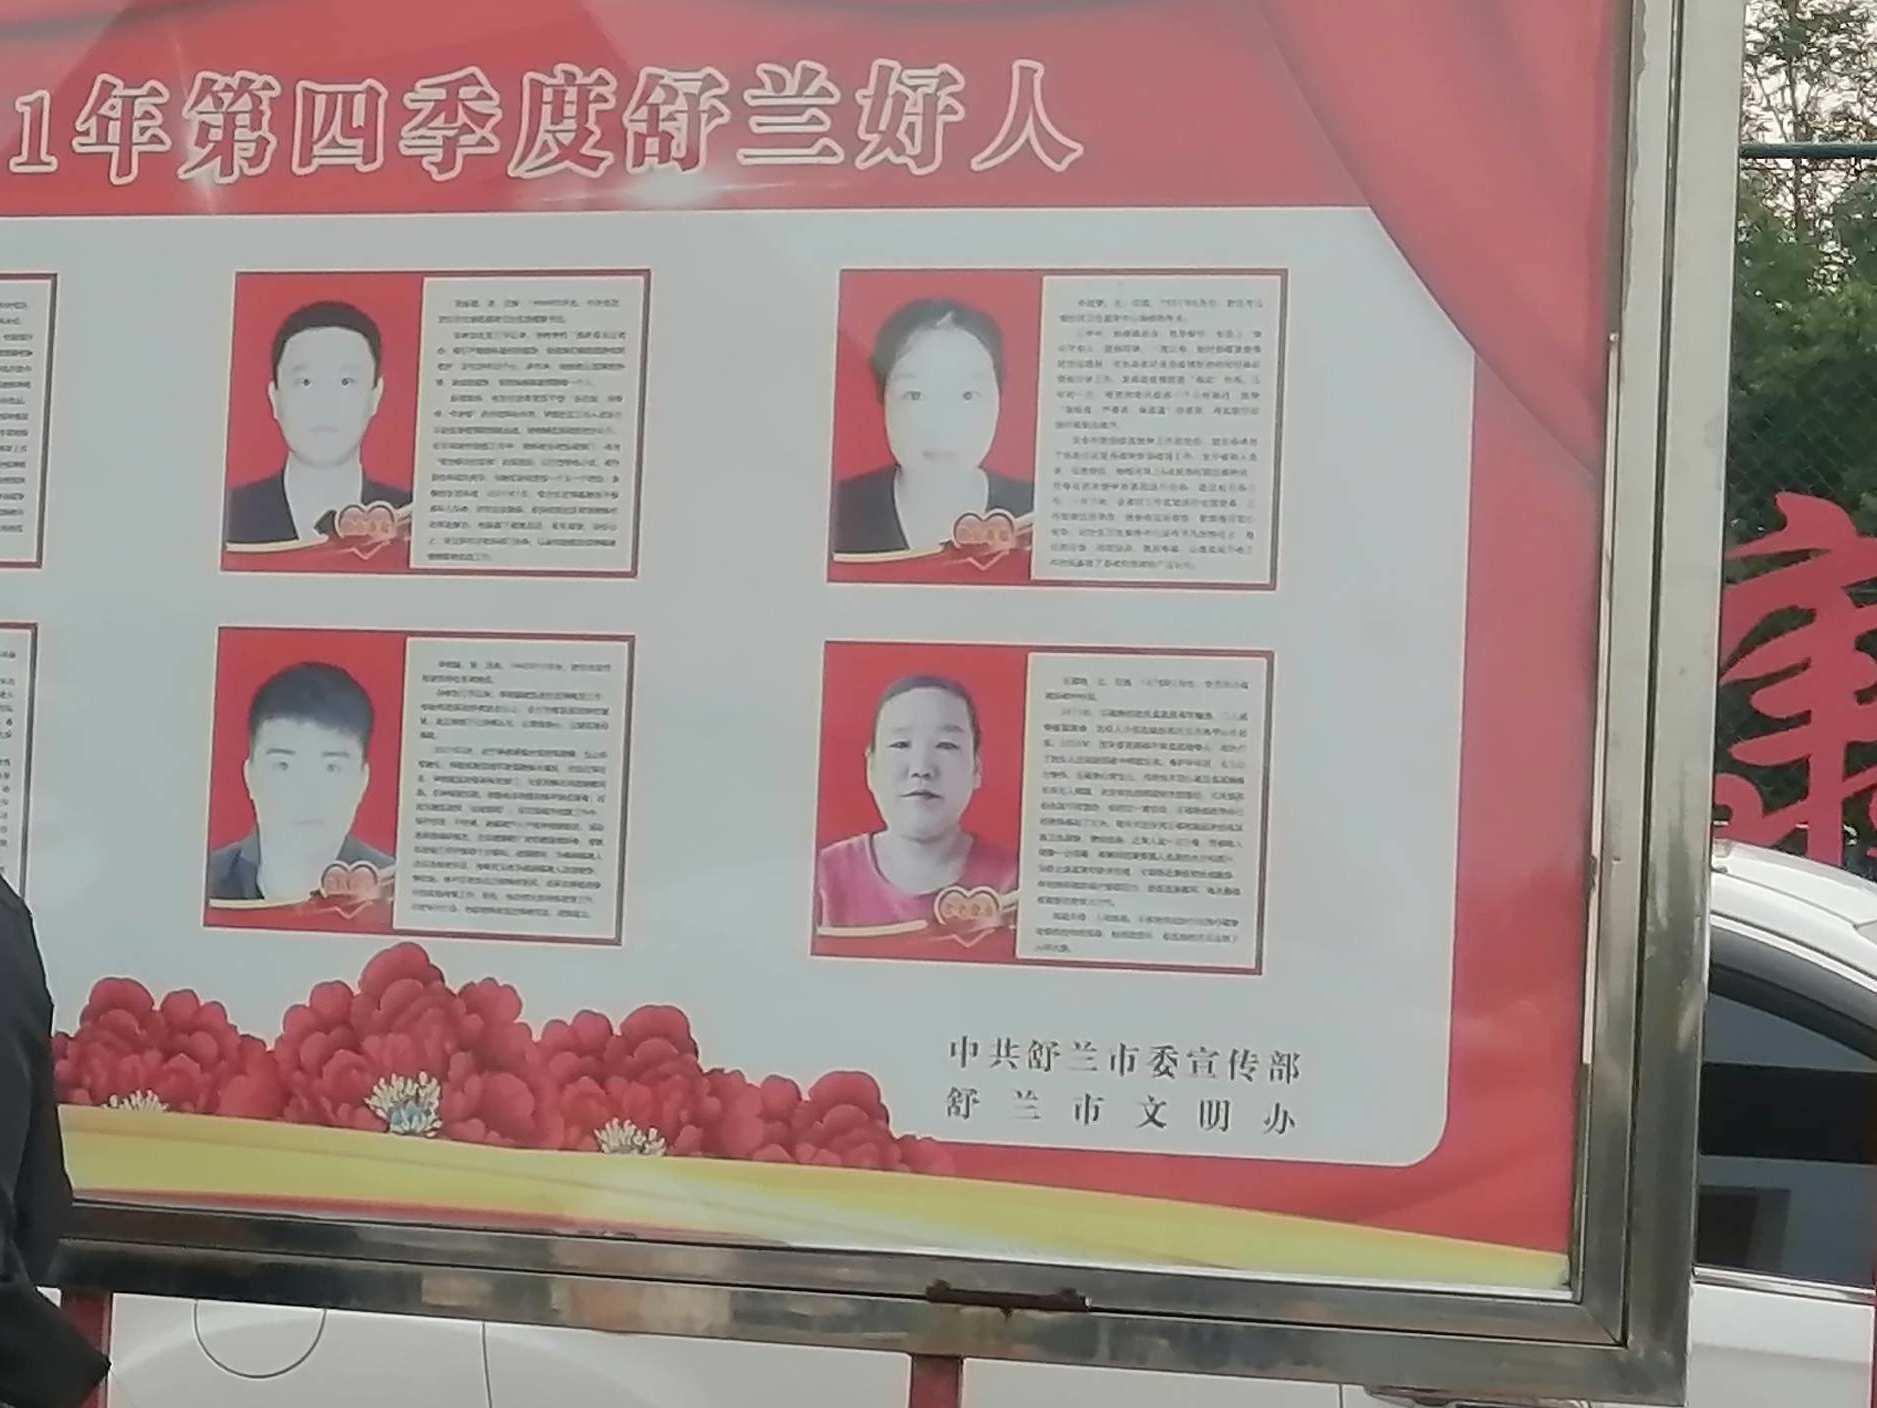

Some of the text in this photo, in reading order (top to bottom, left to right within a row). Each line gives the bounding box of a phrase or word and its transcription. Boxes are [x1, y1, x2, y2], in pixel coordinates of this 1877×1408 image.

[948, 1034, 1303, 1085] 中共舒兰市委宣传部
